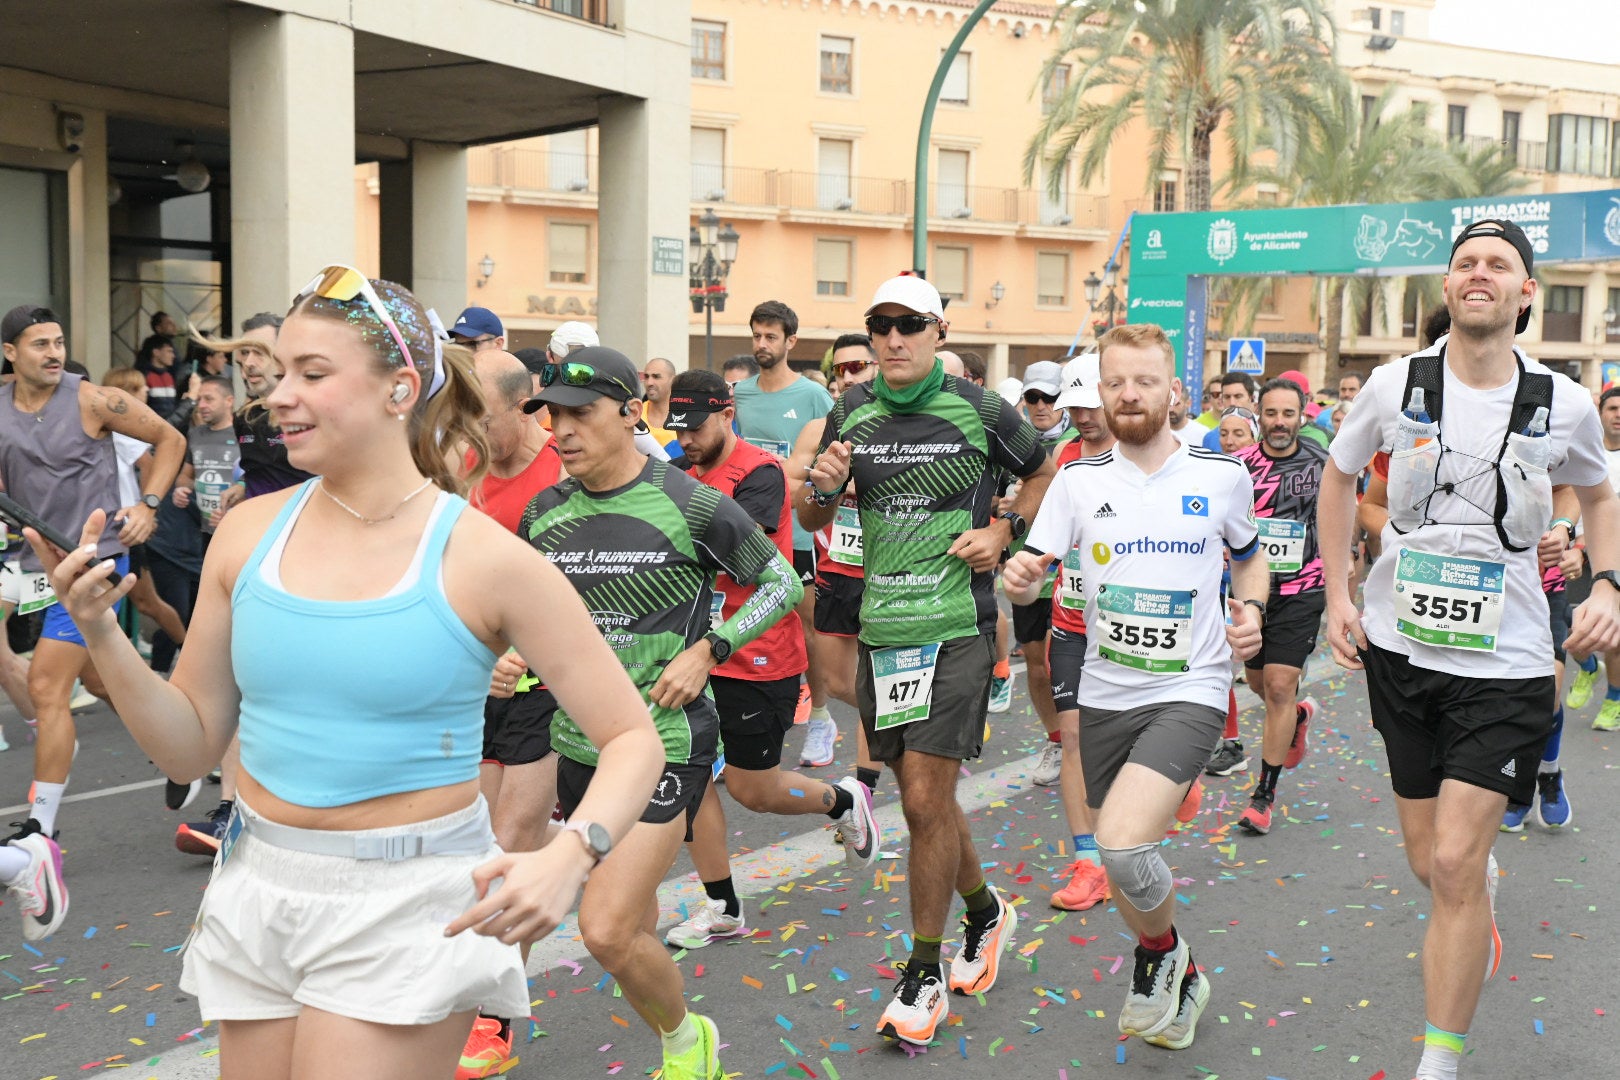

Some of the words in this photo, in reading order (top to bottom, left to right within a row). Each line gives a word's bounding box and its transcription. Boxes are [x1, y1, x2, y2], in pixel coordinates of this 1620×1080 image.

[1473, 200, 1551, 217] MARATÓN
[1243, 229, 1309, 243] Ayuntamiento
[1249, 241, 1262, 251] de
[1263, 240, 1301, 250] Alicante
[853, 443, 890, 454] BLADE
[899, 443, 962, 454] RUNNERS
[873, 455, 935, 464] CALASPARRA
[891, 496, 931, 507] Llorente
[1093, 510, 1117, 519] adidas
[1114, 535, 1207, 556] orthomol
[544, 551, 586, 564] BLADE
[594, 551, 668, 564] RUNNERS
[564, 565, 635, 575] CALASPARRA
[1440, 568, 1466, 579] Elche
[904, 573, 939, 586] MERINO
[1439, 575, 1480, 587] Alicante
[736, 585, 788, 635] RUNNERS
[1133, 605, 1170, 615] Alicante
[1410, 592, 1483, 624] 3551
[591, 615, 631, 626] lorente
[604, 625, 611, 633] &
[601, 633, 634, 644] rraga
[1108, 621, 1177, 650] 3553
[888, 678, 921, 703] 477
